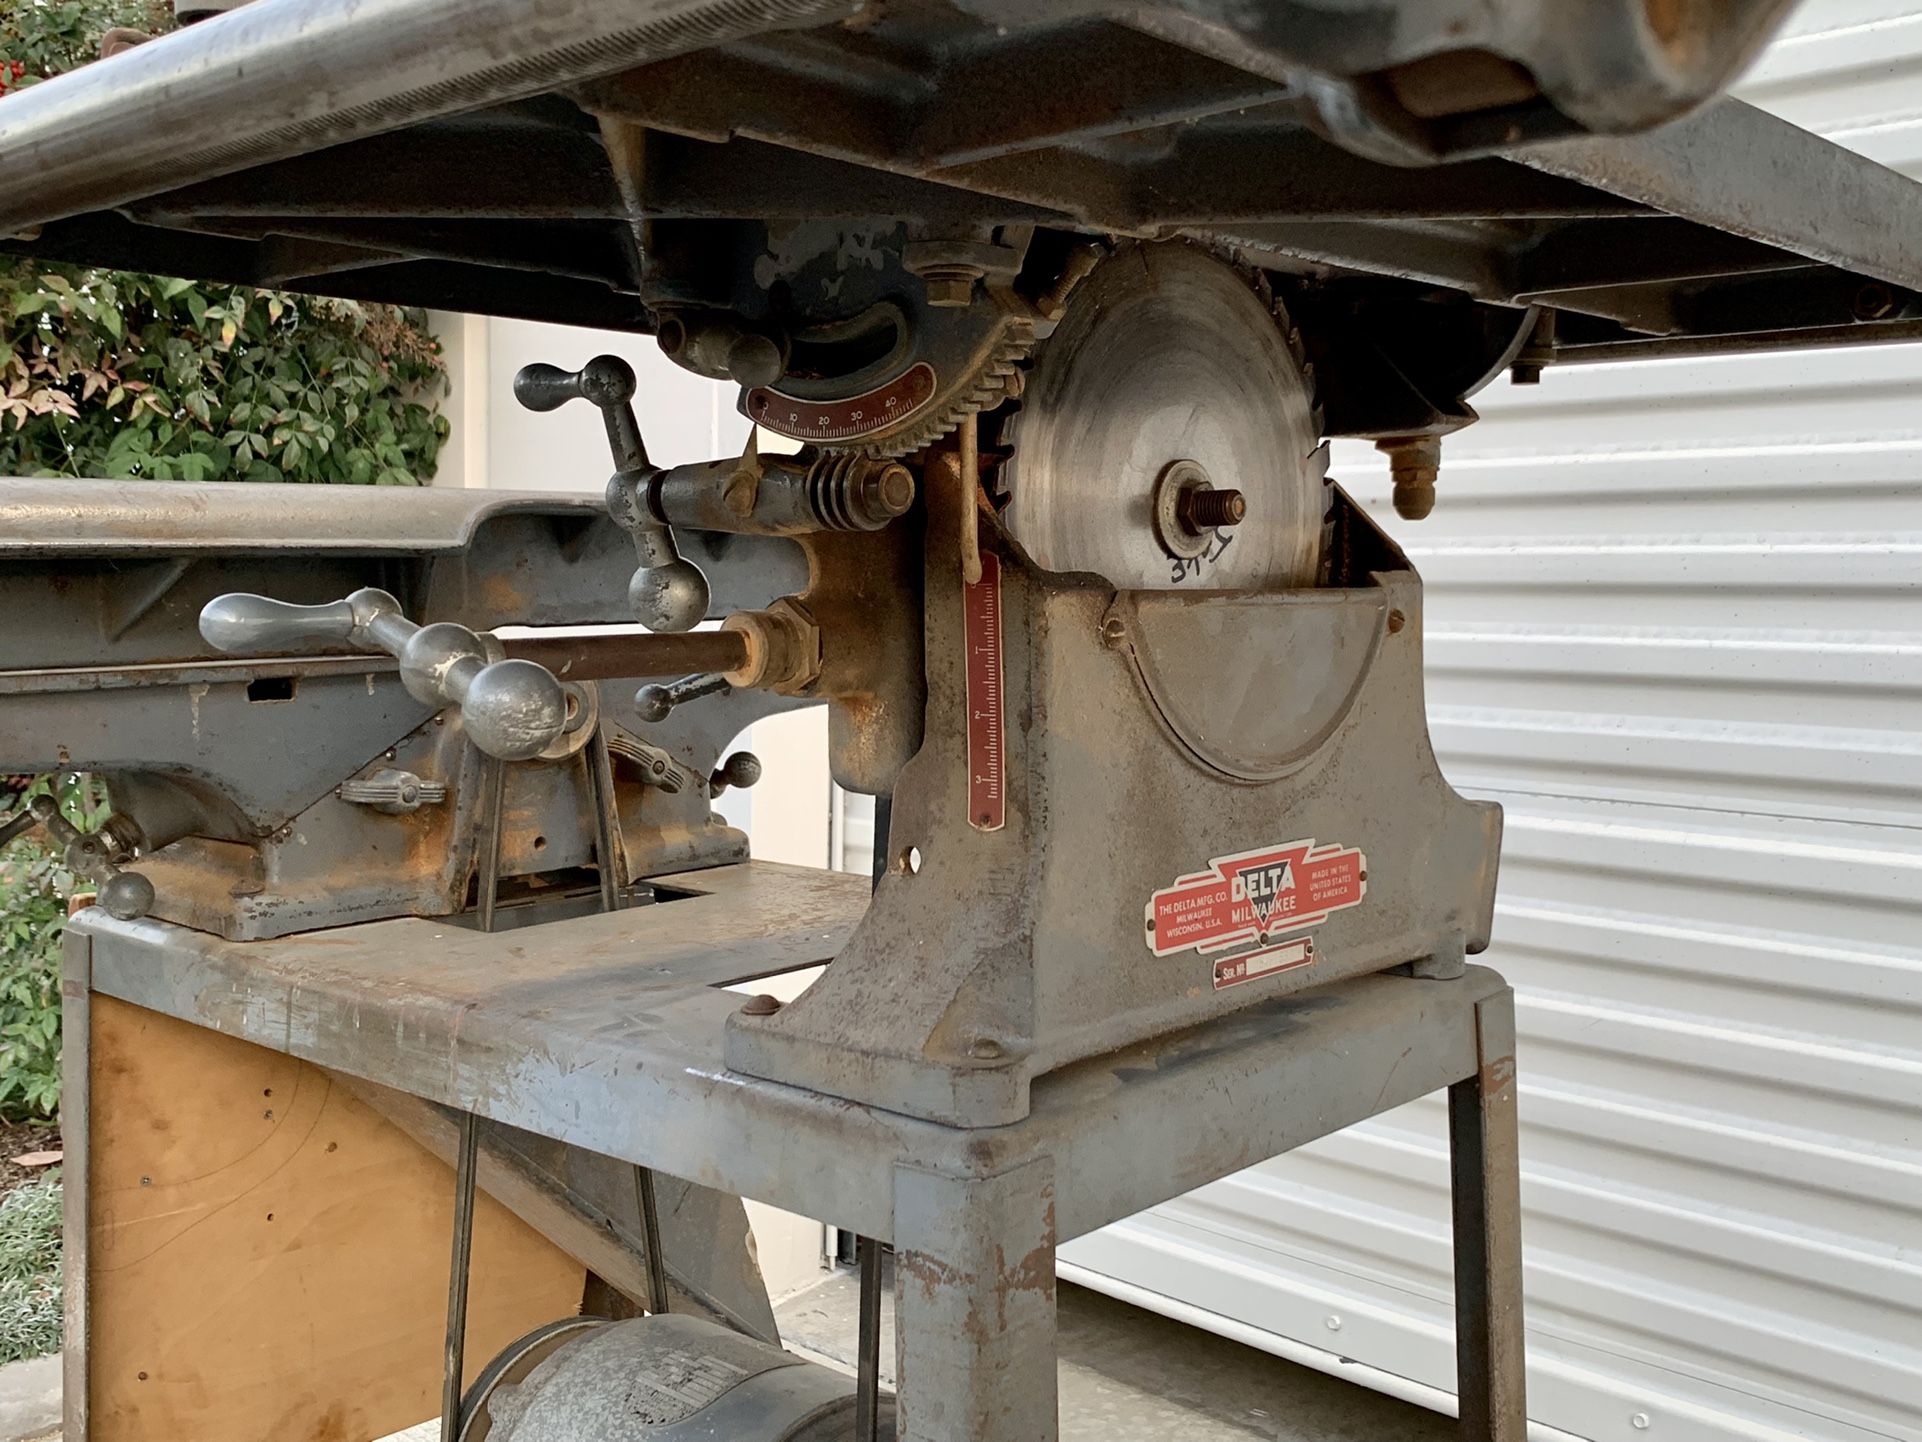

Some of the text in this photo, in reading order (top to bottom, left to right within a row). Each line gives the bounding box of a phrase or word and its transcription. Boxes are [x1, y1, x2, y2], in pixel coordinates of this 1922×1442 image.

[762, 396, 897, 425] 0 10 20 30 40
[975, 710, 981, 719] 2
[975, 775, 981, 784] 3
[1311, 864, 1349, 880] MADE IN THE
[1231, 864, 1296, 903] DELTA
[1309, 874, 1351, 891] UNITED STATES
[1313, 886, 1348, 902] OF AMERICA
[1159, 891, 1228, 917] THE DELTA MFG. CO.
[1231, 896, 1297, 924] MILWAUKEE
[1176, 907, 1212, 924] MILWAUKEE
